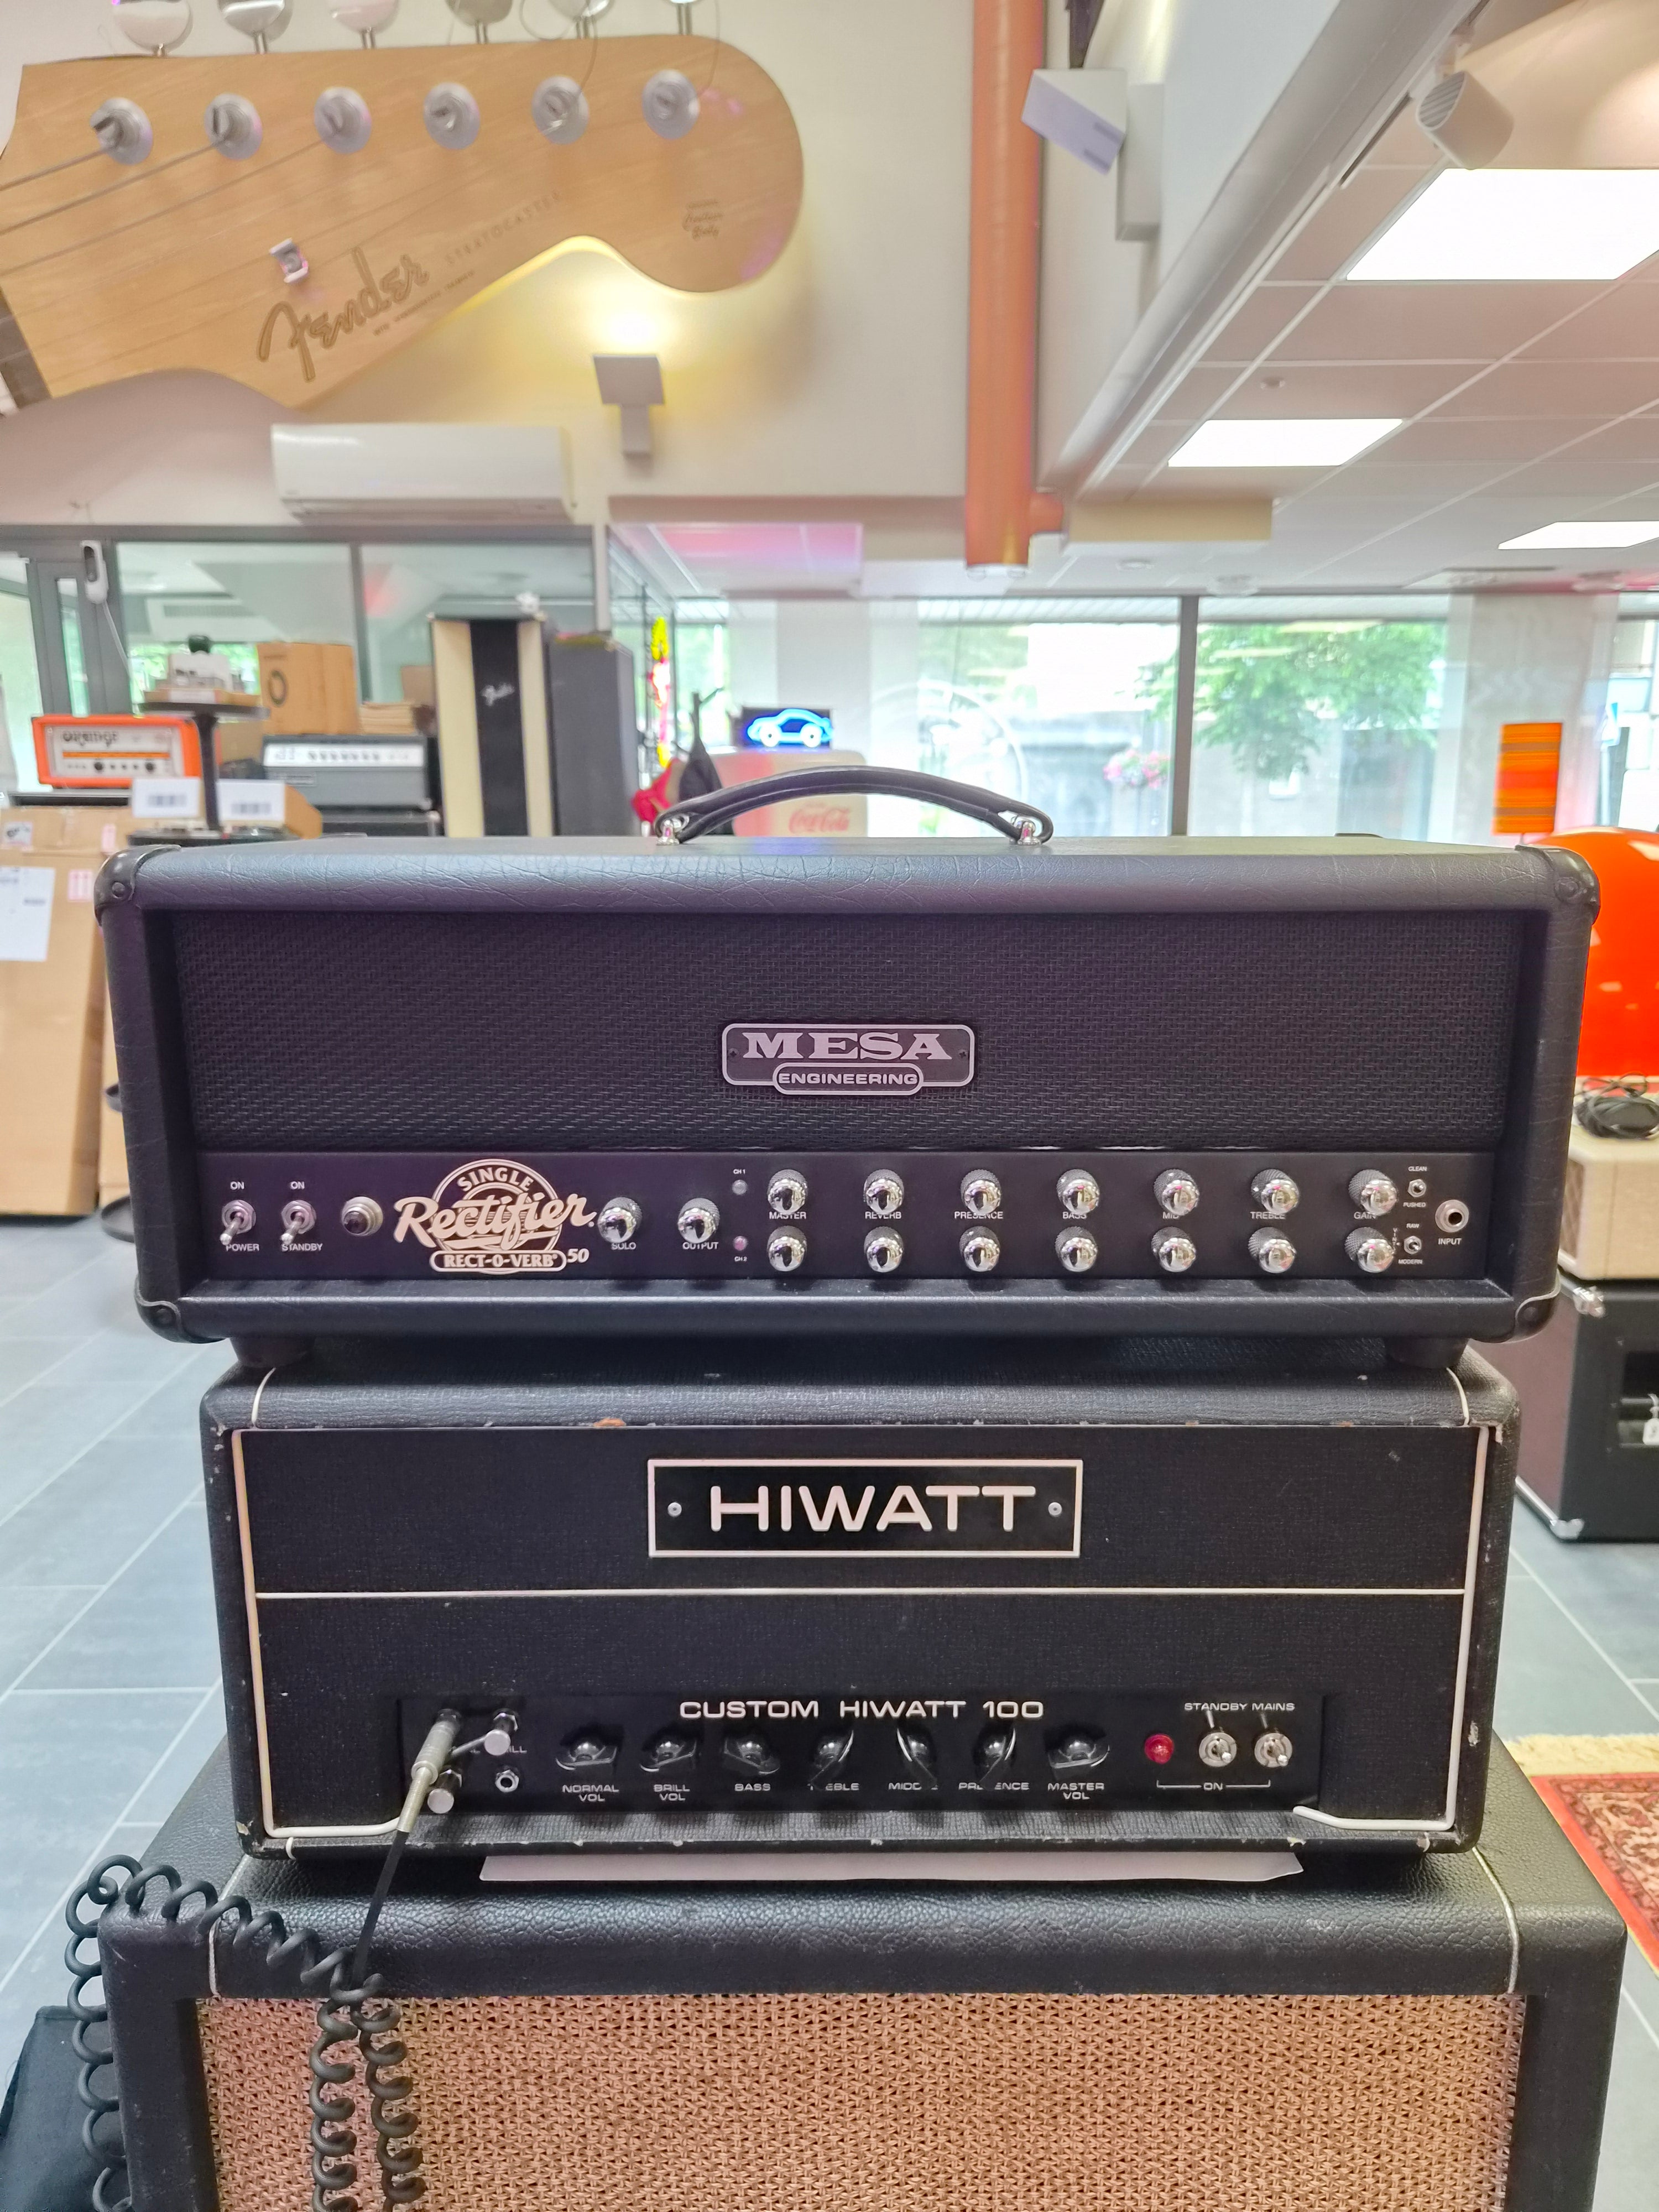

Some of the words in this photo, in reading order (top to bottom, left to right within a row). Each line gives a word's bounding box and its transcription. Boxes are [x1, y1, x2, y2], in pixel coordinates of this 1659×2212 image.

[256, 246, 430, 383] Fender
[742, 1032, 952, 1060] MESA
[779, 1073, 917, 1084] ENGINEERING
[457, 1167, 534, 1191] SINGLE
[230, 1181, 244, 1190] ON
[290, 1181, 305, 1190] ON
[394, 1192, 597, 1250] Rectifier
[226, 1243, 259, 1251] POWER
[281, 1243, 323, 1251] STANDBY
[682, 1241, 718, 1250] OUTPUT
[567, 1248, 589, 1263] 50
[711, 1485, 1036, 1532] HIWATT
[680, 1700, 819, 1719] CUSTOM
[839, 1700, 967, 1718] HIWATT
[983, 1700, 1044, 1718] 100
[1185, 1703, 1248, 1711] STANDBY
[1252, 1703, 1295, 1711] MAINS
[562, 1785, 619, 1793] NORMAL
[1203, 1782, 1223, 1791] ON
[578, 1793, 606, 1802] VOL
[659, 1793, 686, 1801] VOL
